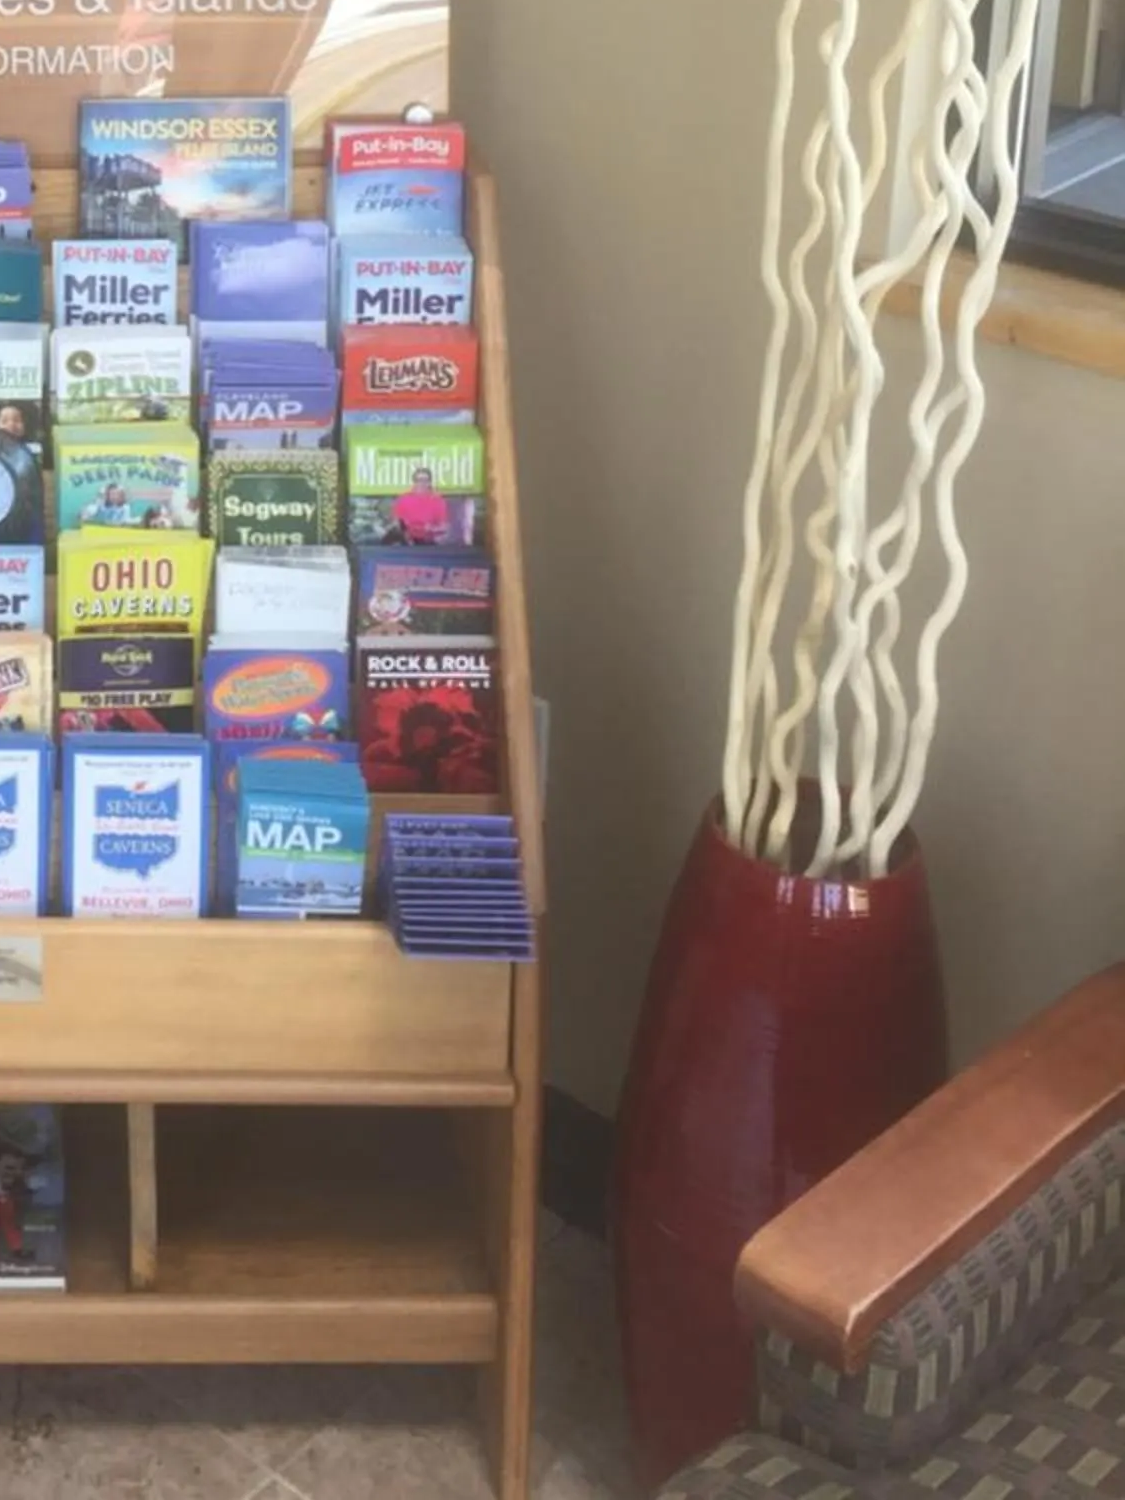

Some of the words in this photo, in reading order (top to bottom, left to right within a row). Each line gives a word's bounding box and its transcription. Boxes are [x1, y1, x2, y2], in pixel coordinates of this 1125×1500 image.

[91, 117, 205, 141] WINDSOR
[208, 116, 279, 140] ESSEX
[351, 135, 450, 158] Put-in-Bay
[363, 183, 394, 197] JET
[62, 244, 172, 264] PUT-IN-BAY
[356, 259, 466, 277] PUT-IN-BAY
[63, 274, 171, 306] Miller
[355, 286, 465, 315] Miller
[64, 305, 168, 326] Ferries
[4, 366, 39, 385] PLAY
[368, 357, 458, 392] LEHMAN'S
[214, 400, 304, 423] MAP
[69, 466, 122, 487] DEER
[126, 466, 184, 488] PARK
[224, 496, 316, 523] Segway
[235, 526, 304, 546] Tours
[91, 558, 174, 593] OHIO
[74, 597, 194, 620] CAVERNS
[367, 655, 422, 671] ROCK
[424, 656, 439, 671] &
[442, 654, 491, 671] ROLL
[104, 693, 136, 706] FREE
[138, 692, 173, 705] PLAY
[105, 800, 170, 815] SENECA
[98, 838, 173, 855] CAVERNS
[246, 819, 343, 853] MAP
[81, 897, 151, 910] BELLEVUE,
[158, 896, 194, 910] OHIO
